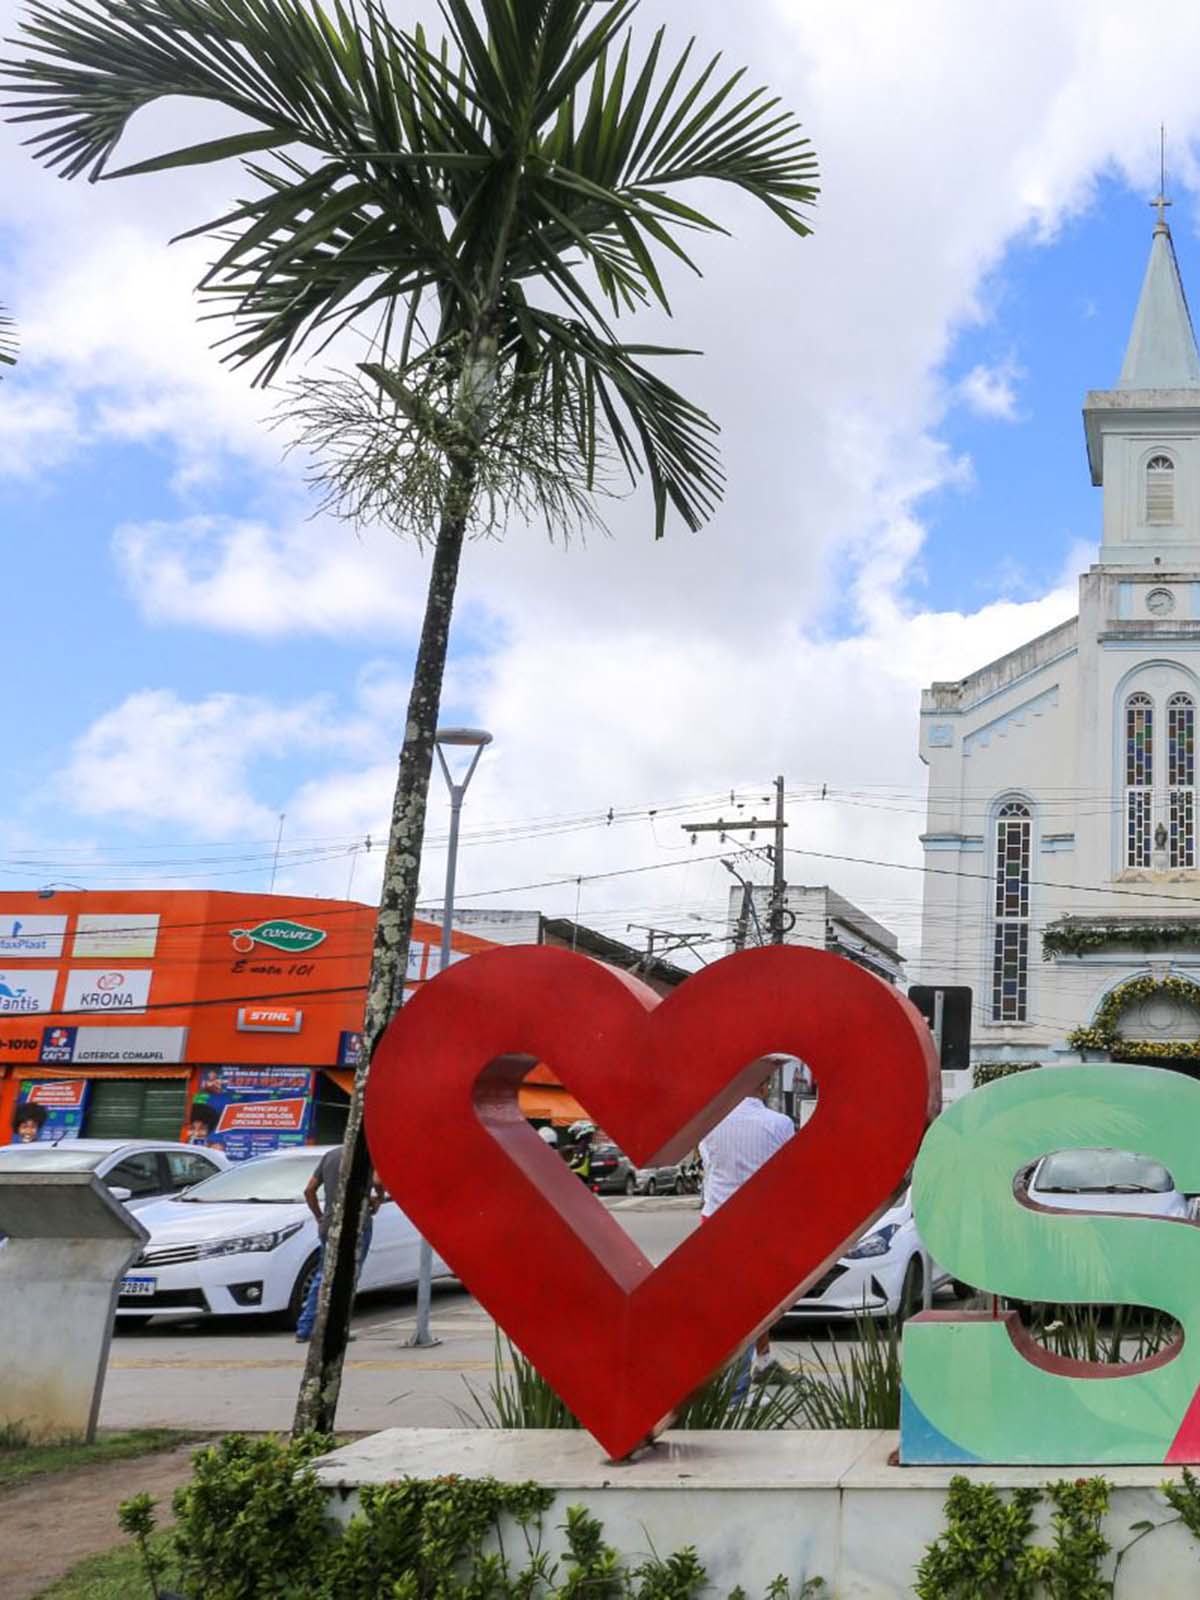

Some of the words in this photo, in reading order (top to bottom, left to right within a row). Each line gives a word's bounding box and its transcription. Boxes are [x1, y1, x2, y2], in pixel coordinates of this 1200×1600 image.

[80, 993, 133, 1007] KRONA
[249, 1011, 290, 1022] STIHL
[122, 1051, 163, 1060] COMAPEL
